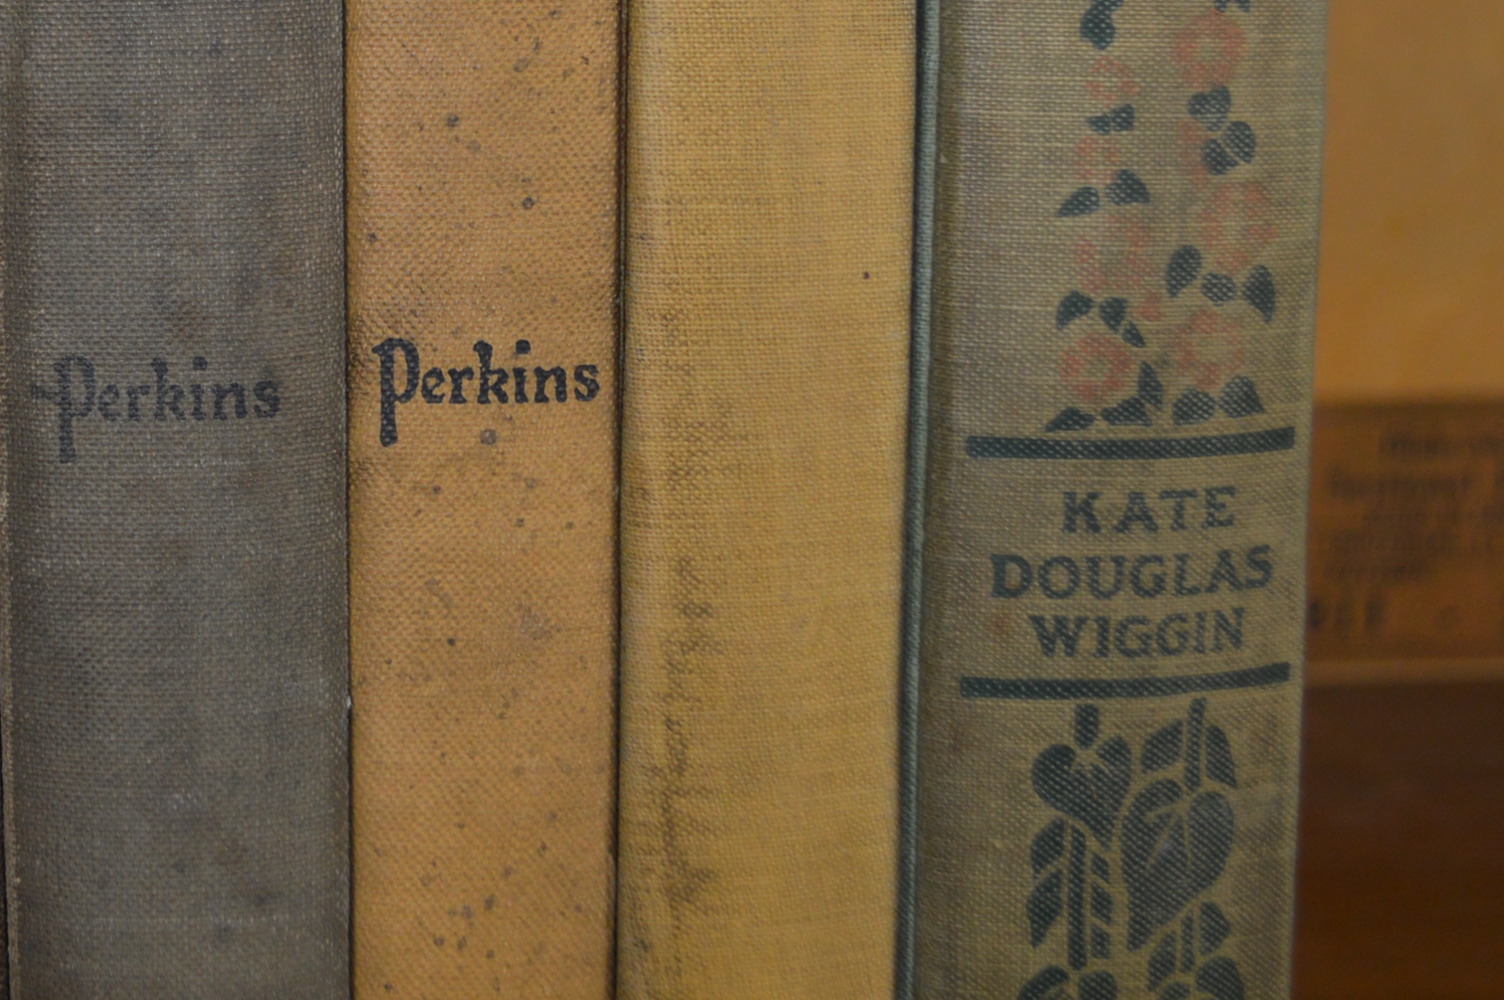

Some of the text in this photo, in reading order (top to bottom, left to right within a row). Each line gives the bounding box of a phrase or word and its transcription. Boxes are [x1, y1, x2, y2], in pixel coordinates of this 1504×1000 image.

[30, 355, 284, 465] Perkins
[370, 336, 601, 447] Perkins
[1060, 486, 1238, 535] KATE
[990, 545, 1275, 600] DOUGLAS
[1028, 607, 1246, 659] WIGGIN
